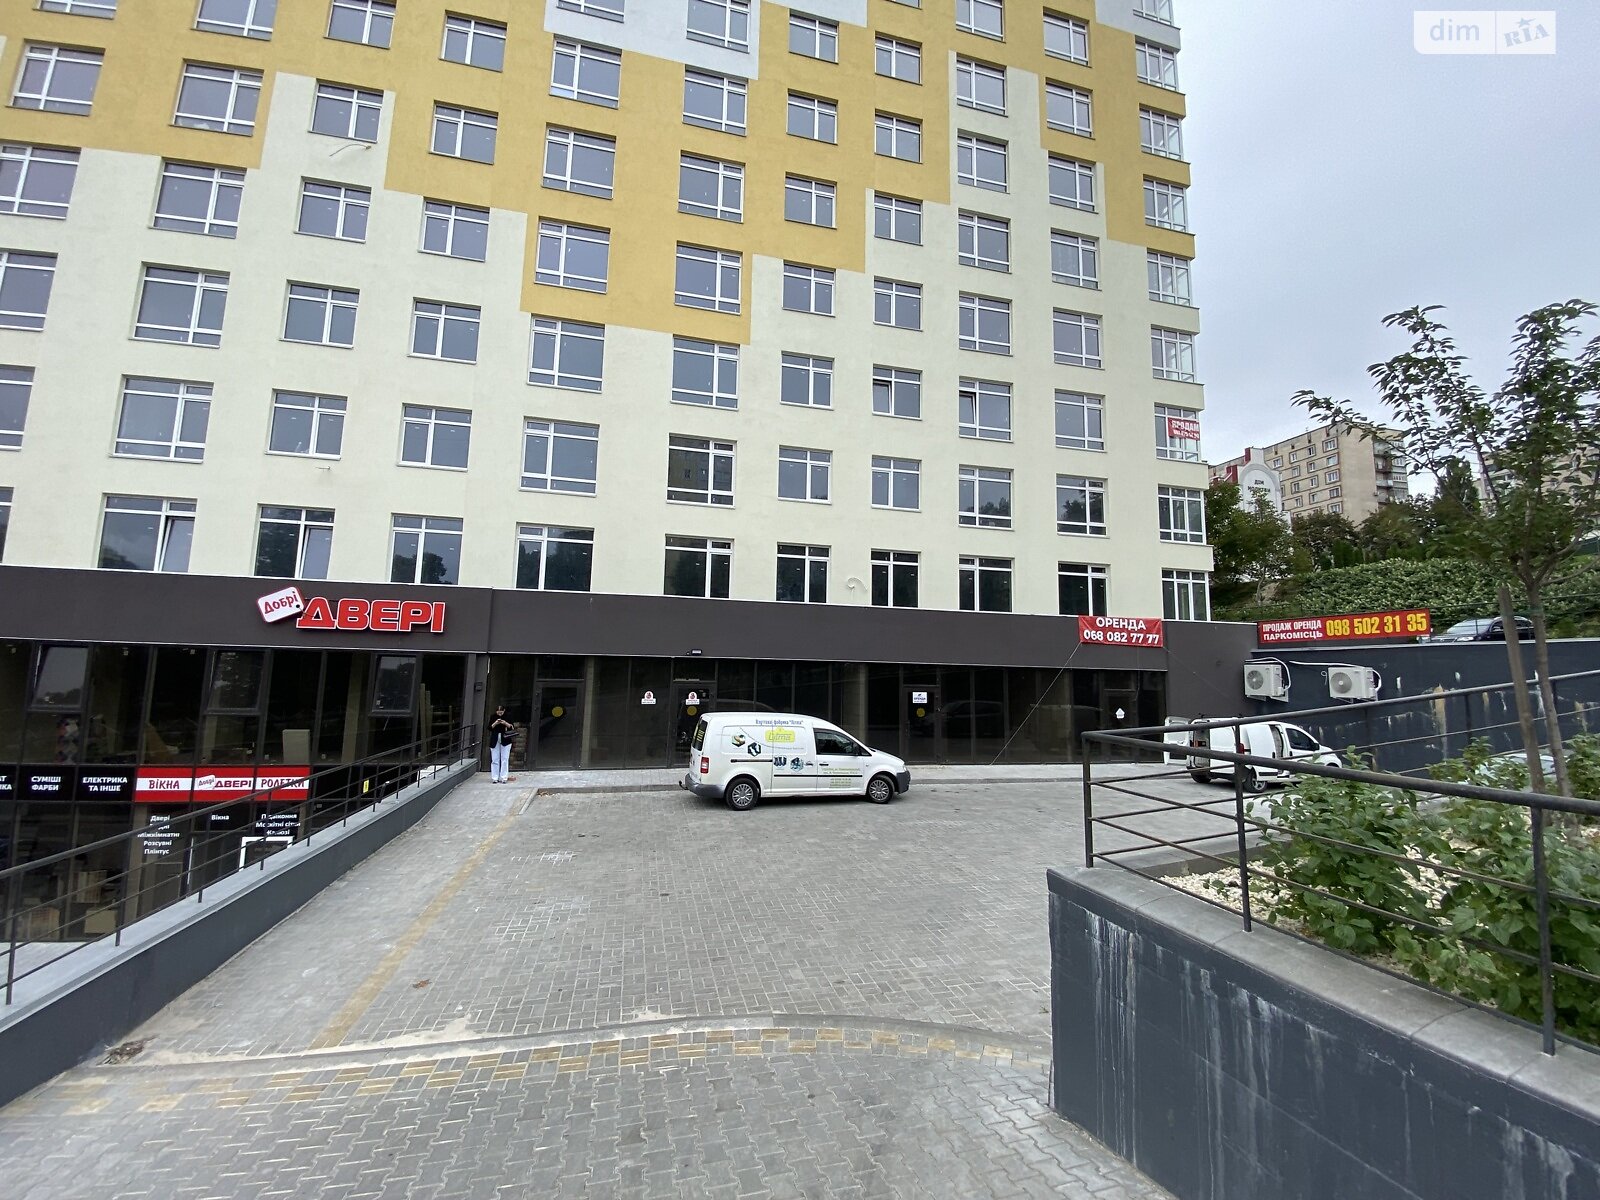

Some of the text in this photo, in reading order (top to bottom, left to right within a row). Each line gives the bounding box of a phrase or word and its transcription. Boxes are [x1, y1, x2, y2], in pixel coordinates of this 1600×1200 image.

[263, 590, 446, 633] Добрі ДВЕРІ
[1095, 617, 1147, 631] ОРЕНДА
[1262, 619, 1322, 633] ПРОДАЖ ОРЕНДА
[1325, 613, 1427, 637] 098 502 31 35
[1083, 629, 1160, 644] 068 082 77 77
[1263, 631, 1323, 641] ПАРКОМІСЦЬ
[82, 776, 128, 784] ЕЛЕКТРИКА
[214, 780, 252, 788] ДВЕРІ
